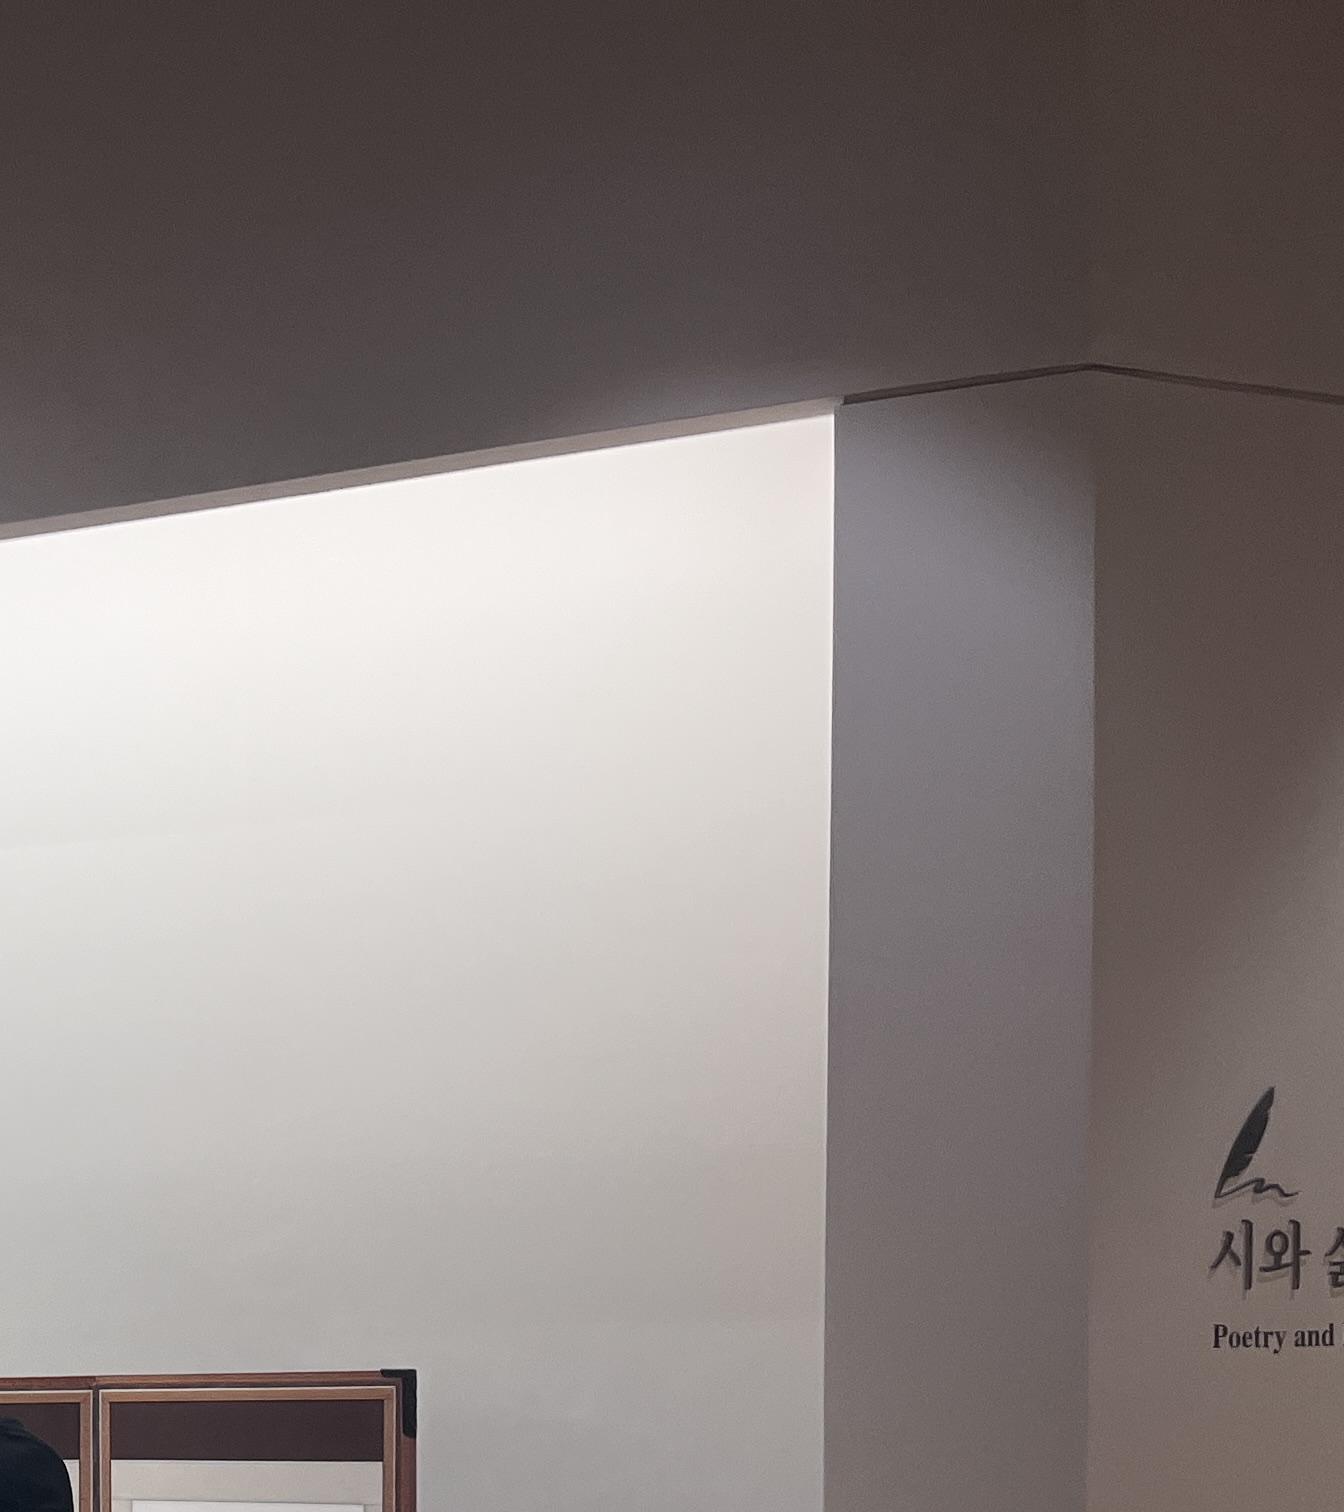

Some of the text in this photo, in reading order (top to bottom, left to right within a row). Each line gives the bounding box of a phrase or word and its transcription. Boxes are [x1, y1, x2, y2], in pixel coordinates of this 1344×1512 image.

[1210, 1218, 1312, 1291] 시와
[1212, 1323, 1287, 1354] Poetry
[1293, 1323, 1334, 1348] and
